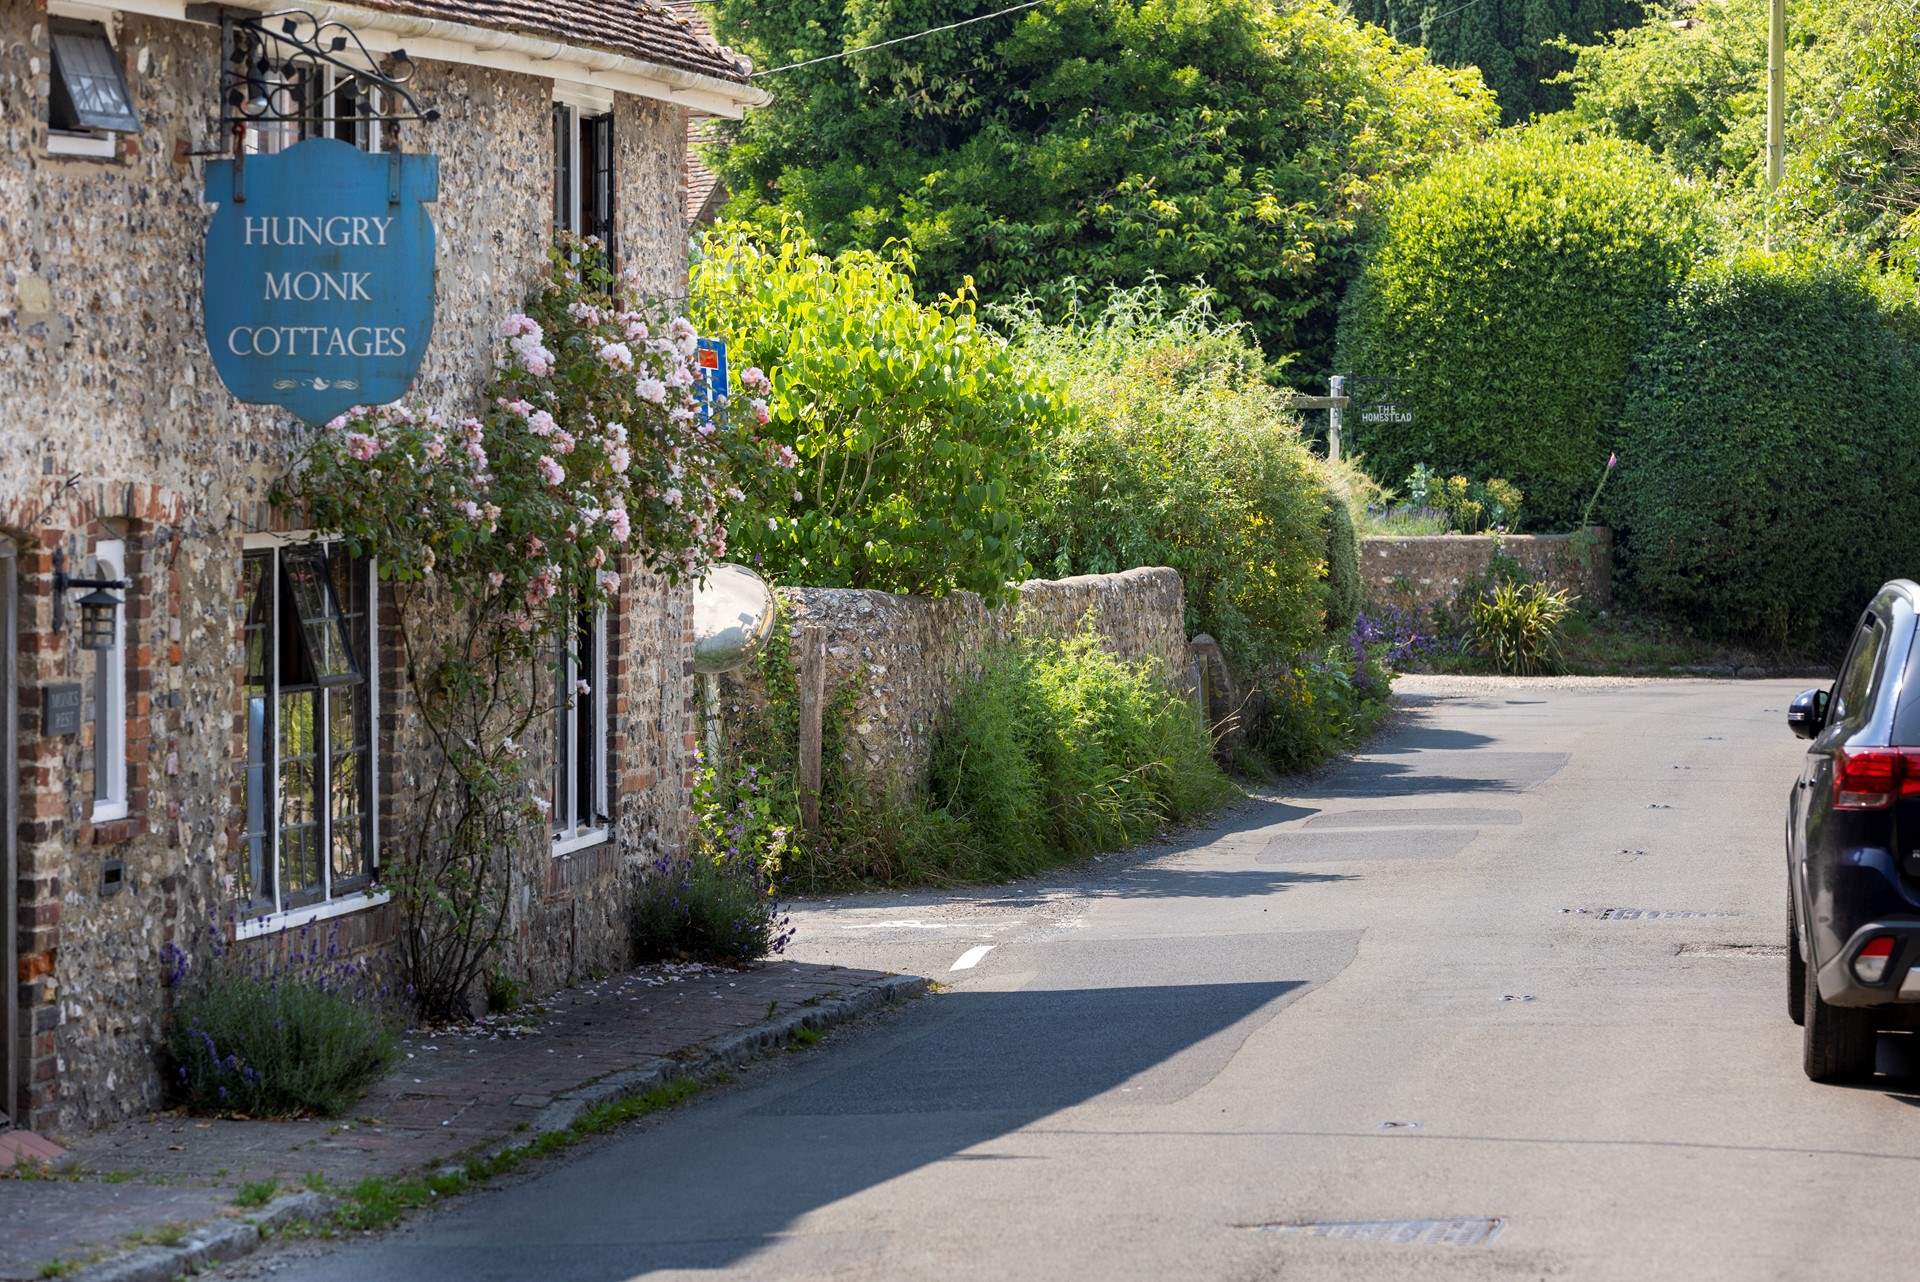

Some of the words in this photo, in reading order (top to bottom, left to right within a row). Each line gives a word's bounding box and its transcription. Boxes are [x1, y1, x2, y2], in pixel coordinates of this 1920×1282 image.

[244, 216, 393, 245] HUNGRY
[264, 271, 372, 300] MONK
[228, 326, 406, 356] COTTAGES
[1362, 413, 1412, 422] HOMESTEAD
[1377, 405, 1396, 414] THE
